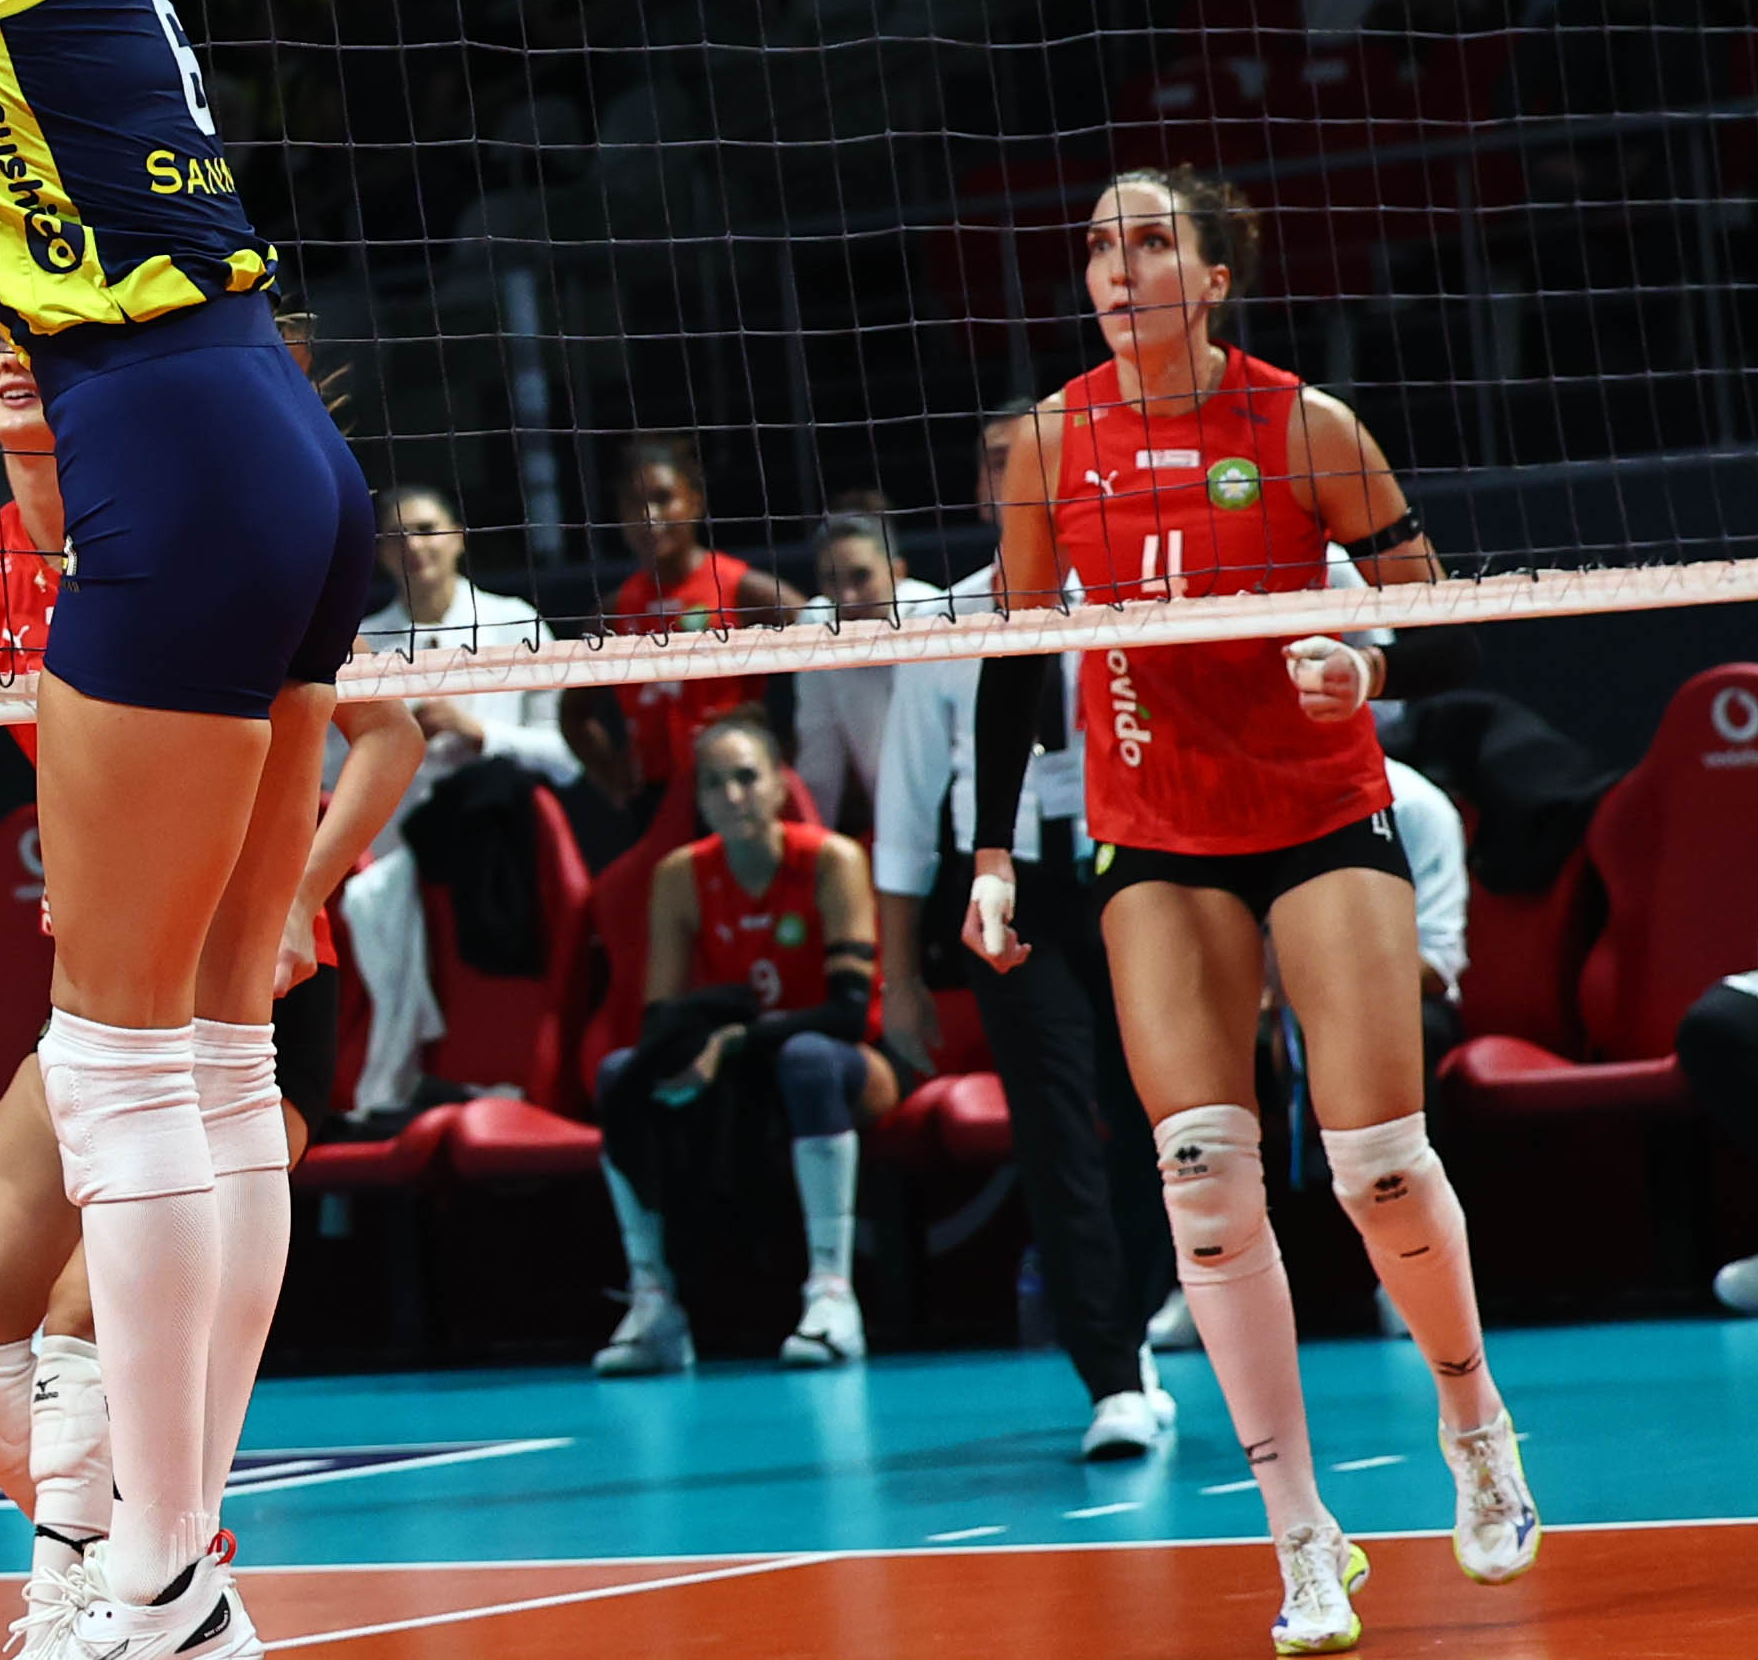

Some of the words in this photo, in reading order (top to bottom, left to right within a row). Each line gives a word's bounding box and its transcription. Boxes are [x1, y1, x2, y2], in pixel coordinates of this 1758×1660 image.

[1141, 530, 1188, 599] 4
[1107, 649, 1152, 768] ovido
[1371, 809, 1392, 842] 4
[749, 958, 782, 1009] 9
